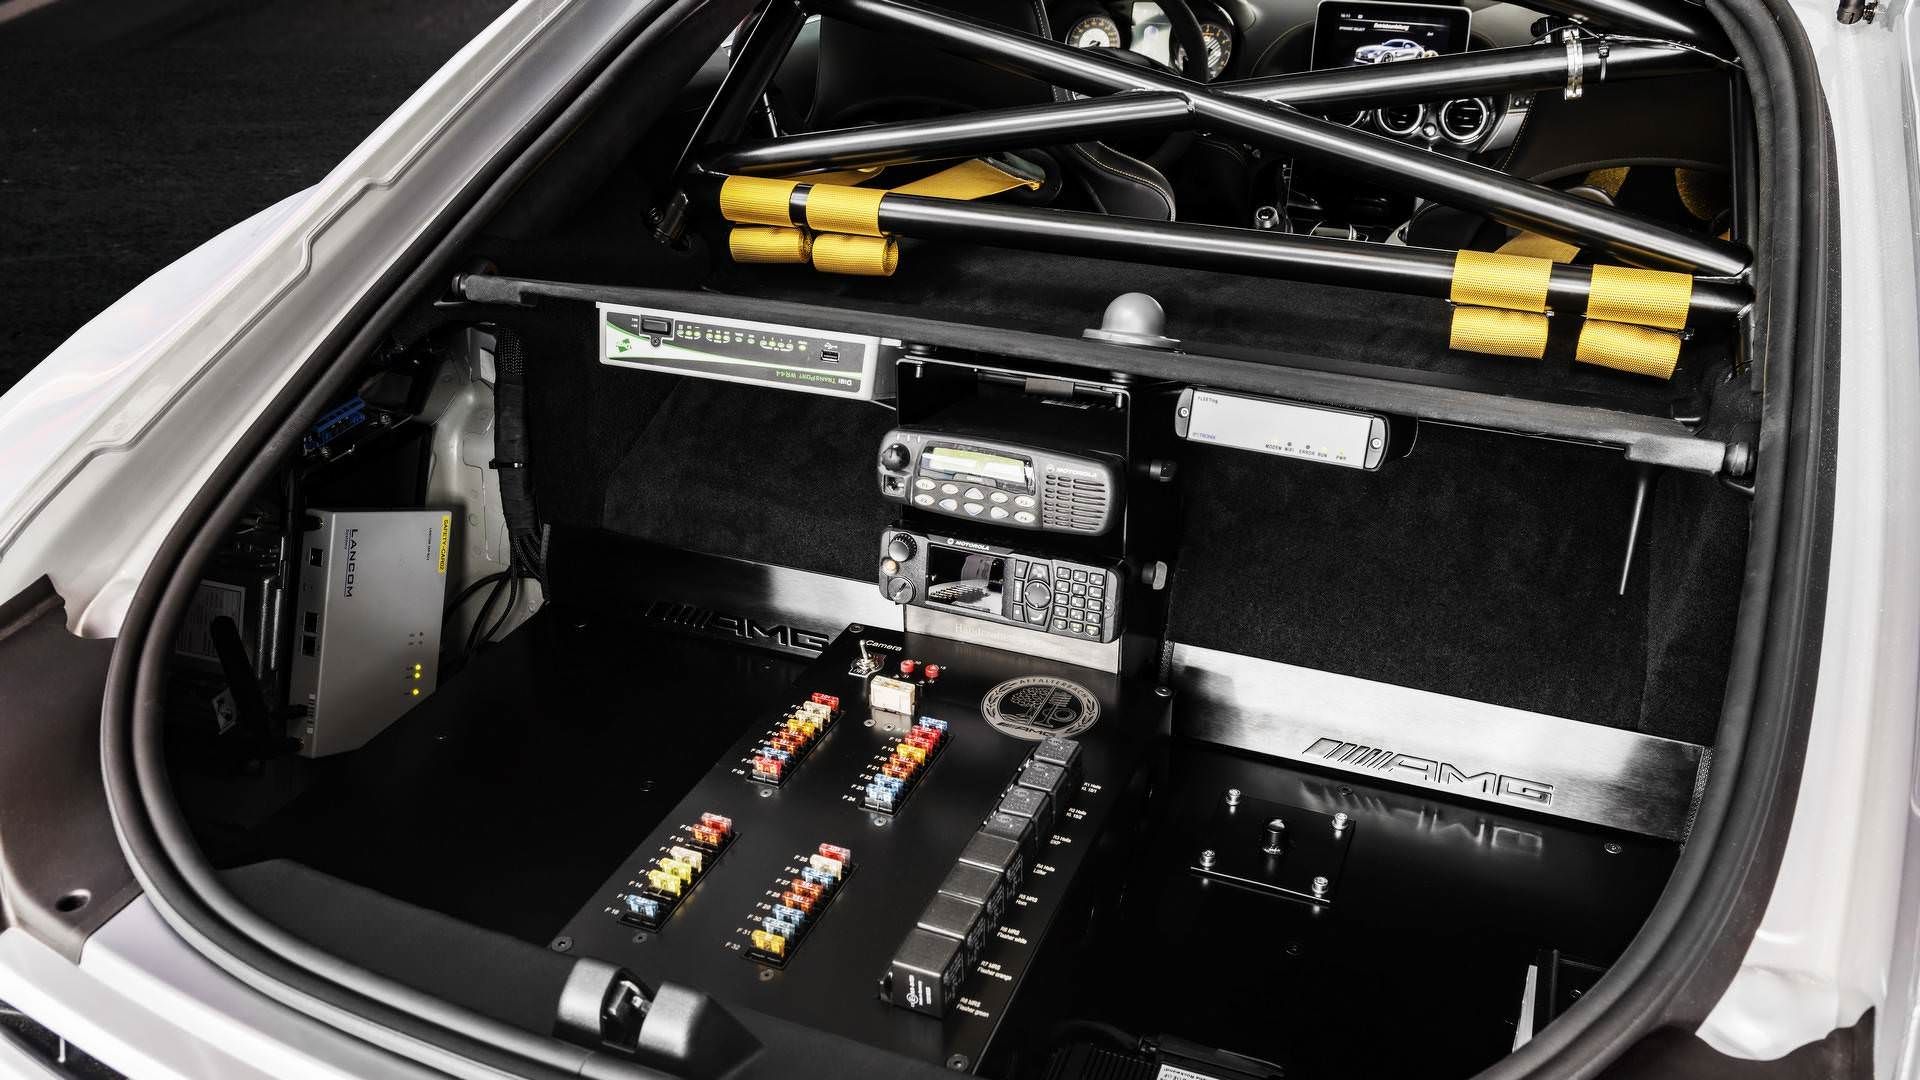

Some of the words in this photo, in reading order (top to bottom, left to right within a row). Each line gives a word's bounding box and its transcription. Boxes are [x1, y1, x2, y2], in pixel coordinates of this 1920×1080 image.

[1056, 466, 1097, 479] MOTOROLA
[954, 540, 990, 551] MOTOROLA
[346, 528, 358, 598] LANCOM
[865, 640, 903, 652] Camera
[1389, 753, 1554, 808] AMG
